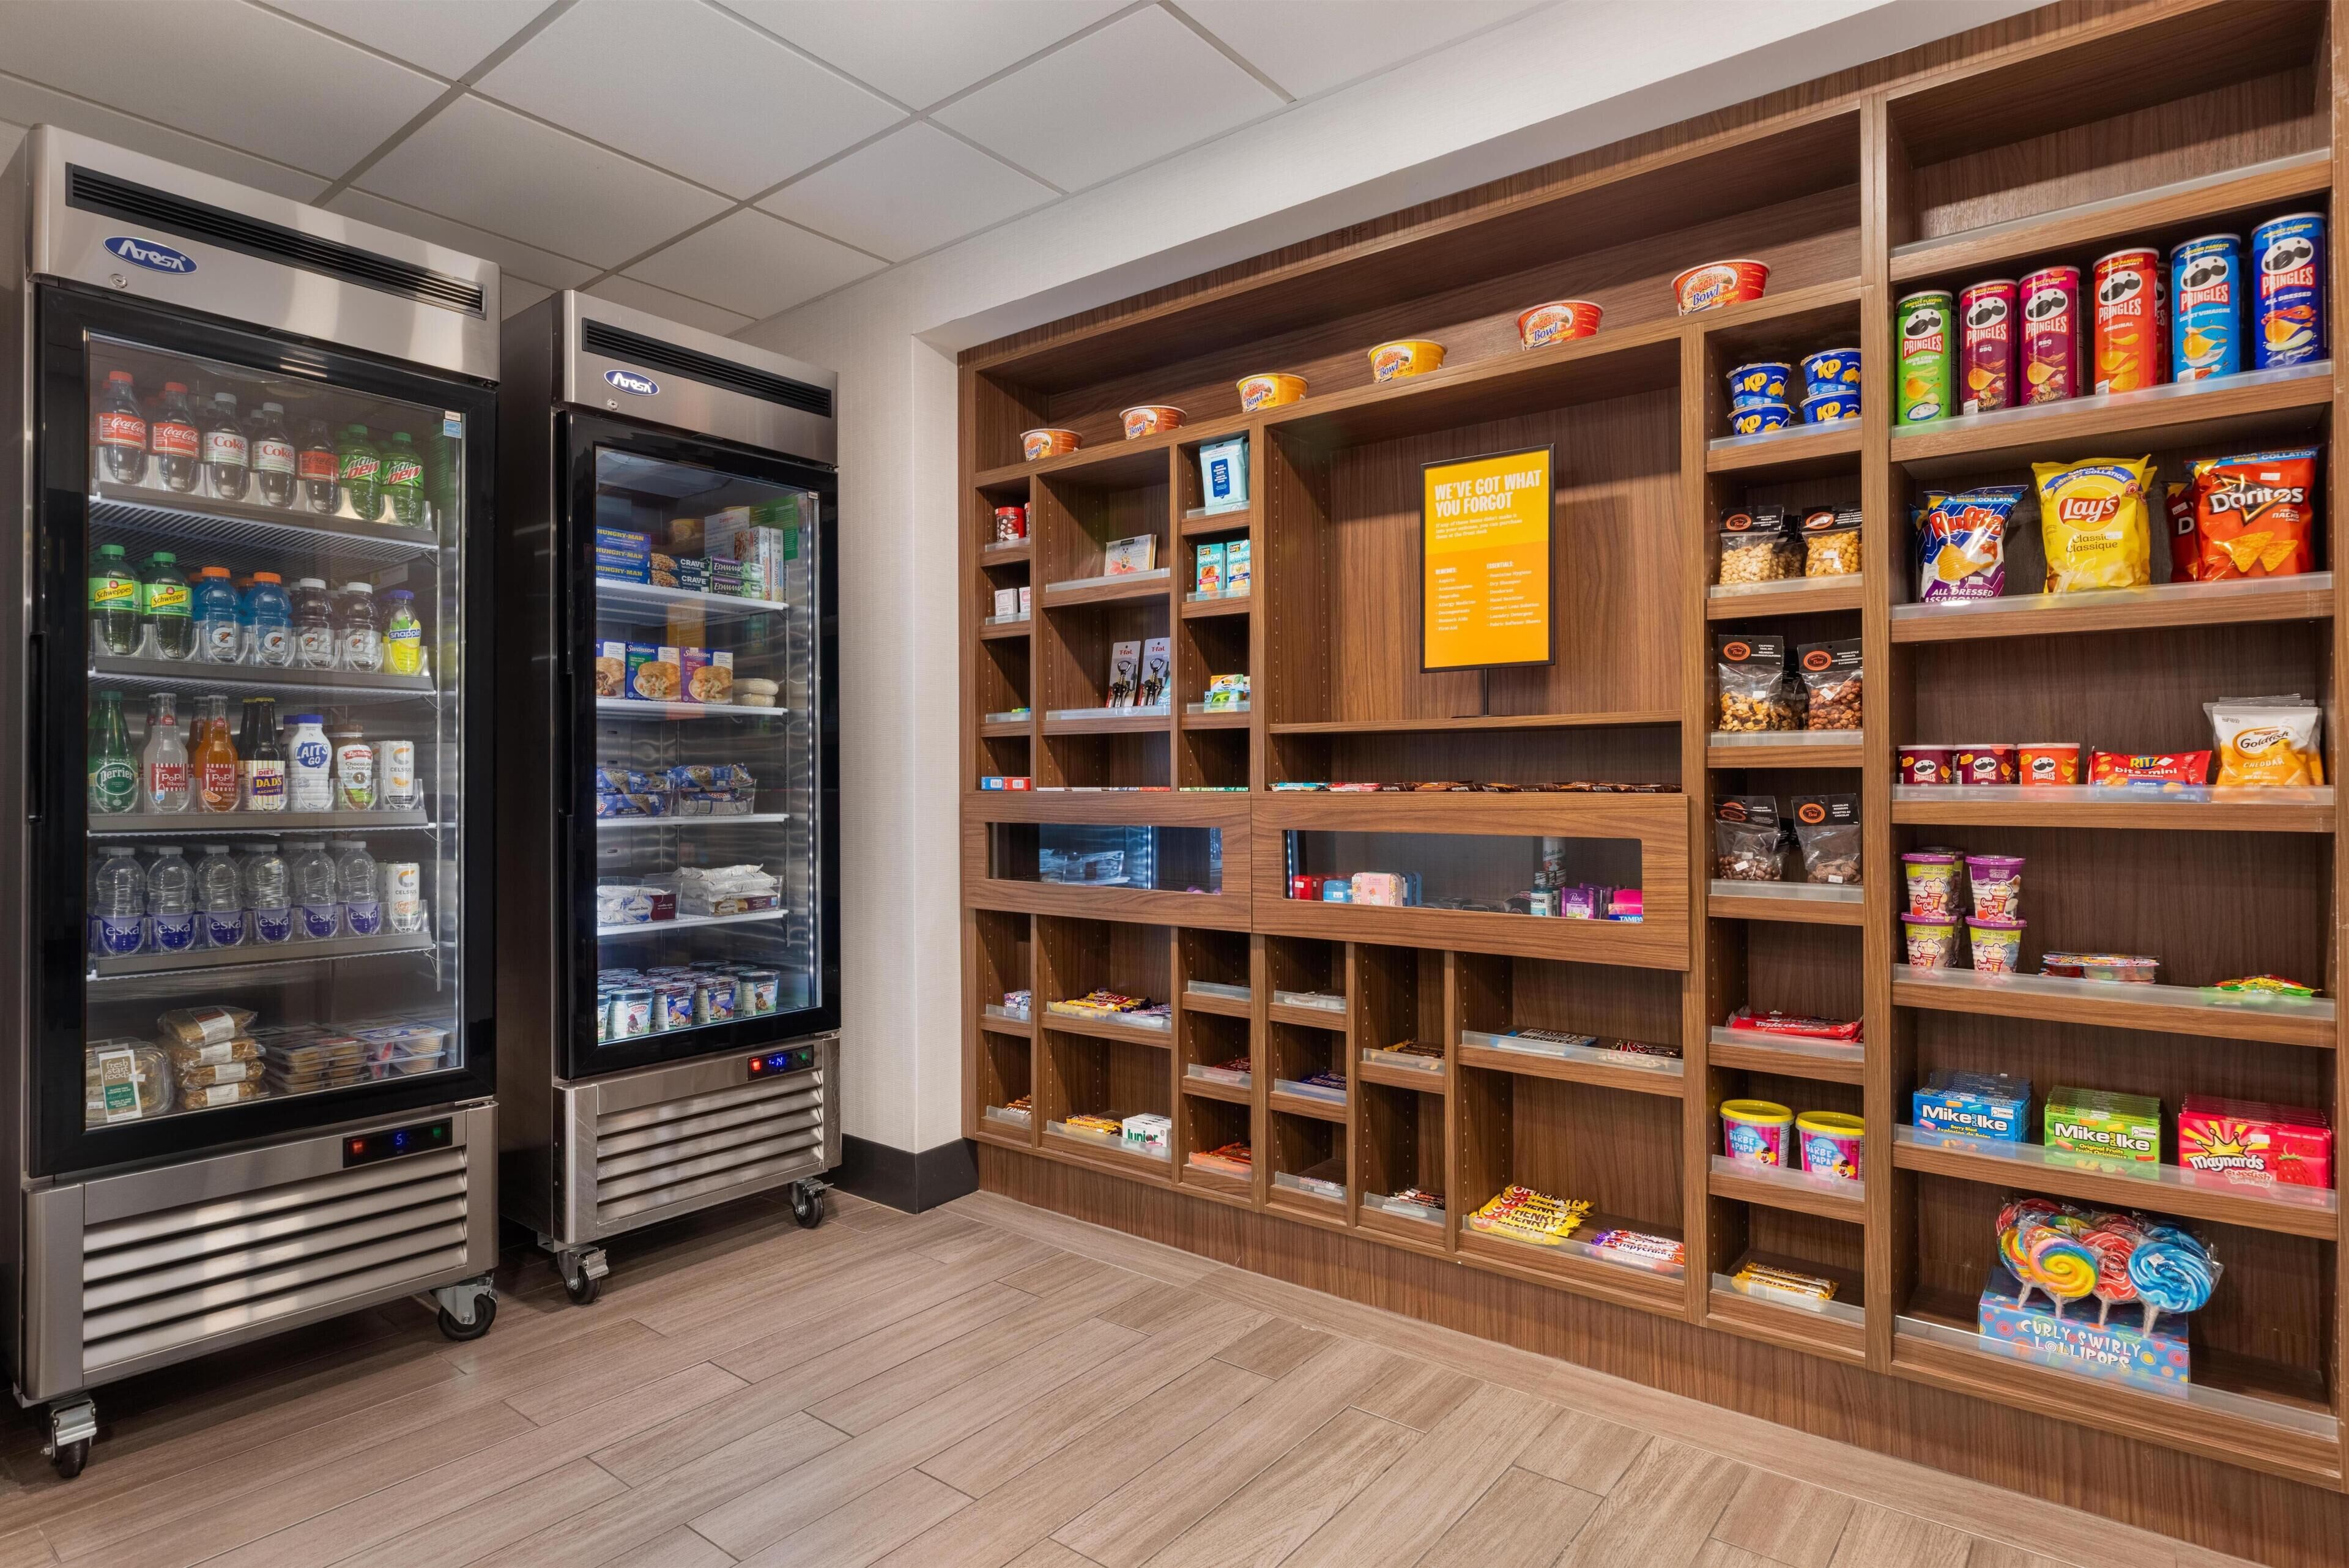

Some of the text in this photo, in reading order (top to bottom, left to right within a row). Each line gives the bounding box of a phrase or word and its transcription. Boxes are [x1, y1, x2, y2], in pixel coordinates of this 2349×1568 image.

[2262, 270, 2314, 295] PRINGLES
[1693, 284, 1719, 305] Bowl
[2181, 288, 2227, 311] PRINGLES
[2278, 291, 2311, 302] DRESSED
[2099, 298, 2141, 324] PRINGLES
[2198, 308, 2230, 318] VINAIGRE
[1534, 322, 1557, 340] Bowl
[2026, 316, 2066, 340] PRINGLES
[2104, 322, 2134, 332] ORIGINAL
[1967, 325, 2006, 347] PRINGLES
[1904, 338, 1942, 357] PRINGLES
[1380, 360, 1398, 377] Bowl
[1818, 359, 1841, 379] KD
[1744, 373, 1767, 392] KD
[1247, 394, 1263, 407] Bowl
[1817, 402, 1841, 421] KD
[1130, 422, 1145, 435] Bowl
[1740, 415, 1761, 433] KD
[214, 436, 245, 450] Coke
[263, 444, 294, 458] Coke
[1028, 445, 1041, 456] Bowl
[2085, 470, 2128, 481] COLLATION
[1434, 469, 1542, 500] WE'VE GOT WHAT
[1435, 492, 1513, 518] YOU FORGOT
[2210, 488, 2303, 513] Doritos
[2063, 496, 2117, 521] Lay's
[1929, 507, 2004, 540] Ruffle
[2066, 541, 2118, 553] Classique
[680, 559, 705, 568] CRAVE
[681, 575, 707, 585] CRAVE
[97, 587, 132, 600] Schweppes
[153, 592, 187, 606] Schweppes
[1951, 589, 1994, 597] DRESSED
[626, 644, 655, 653] Swanson
[683, 649, 710, 658] Swanson
[2241, 730, 2289, 748] Goldfish
[295, 741, 328, 760] LAIT'S
[2130, 757, 2159, 768] RITZ
[2243, 758, 2284, 768] CHEDDAR
[1973, 772, 1995, 781] PRINGLES
[2033, 772, 2055, 781] PRINGLES
[2115, 766, 2140, 775] bits
[256, 777, 283, 788] DAD'S
[1914, 774, 1935, 782] PRINGLES
[1570, 893, 1584, 901] Poise
[1981, 898, 1998, 907] Candy
[259, 916, 289, 927] eska
[351, 910, 377, 920] eska
[106, 925, 139, 936] eska
[158, 923, 190, 934] eska
[211, 919, 241, 930] eska
[1530, 1029, 1584, 1039] HERSHEY'S
[106, 1059, 128, 1069] fresh
[1922, 1105, 1972, 1123] Mike
[1977, 1115, 2007, 1131] Ike
[396, 1134, 403, 1145] 5
[1729, 1132, 1754, 1145] BARBE
[2055, 1123, 2109, 1143] Mike
[2117, 1134, 2150, 1151] Ike
[1735, 1143, 1753, 1152] PAPA
[1806, 1143, 1831, 1157] BARBE
[1812, 1154, 1832, 1165] PAPA
[2225, 1169, 2271, 1180] swedish
[2021, 1318, 2141, 1358] CURLY SWIRLY
[2035, 1336, 2129, 1368] LOLLIPOPS
